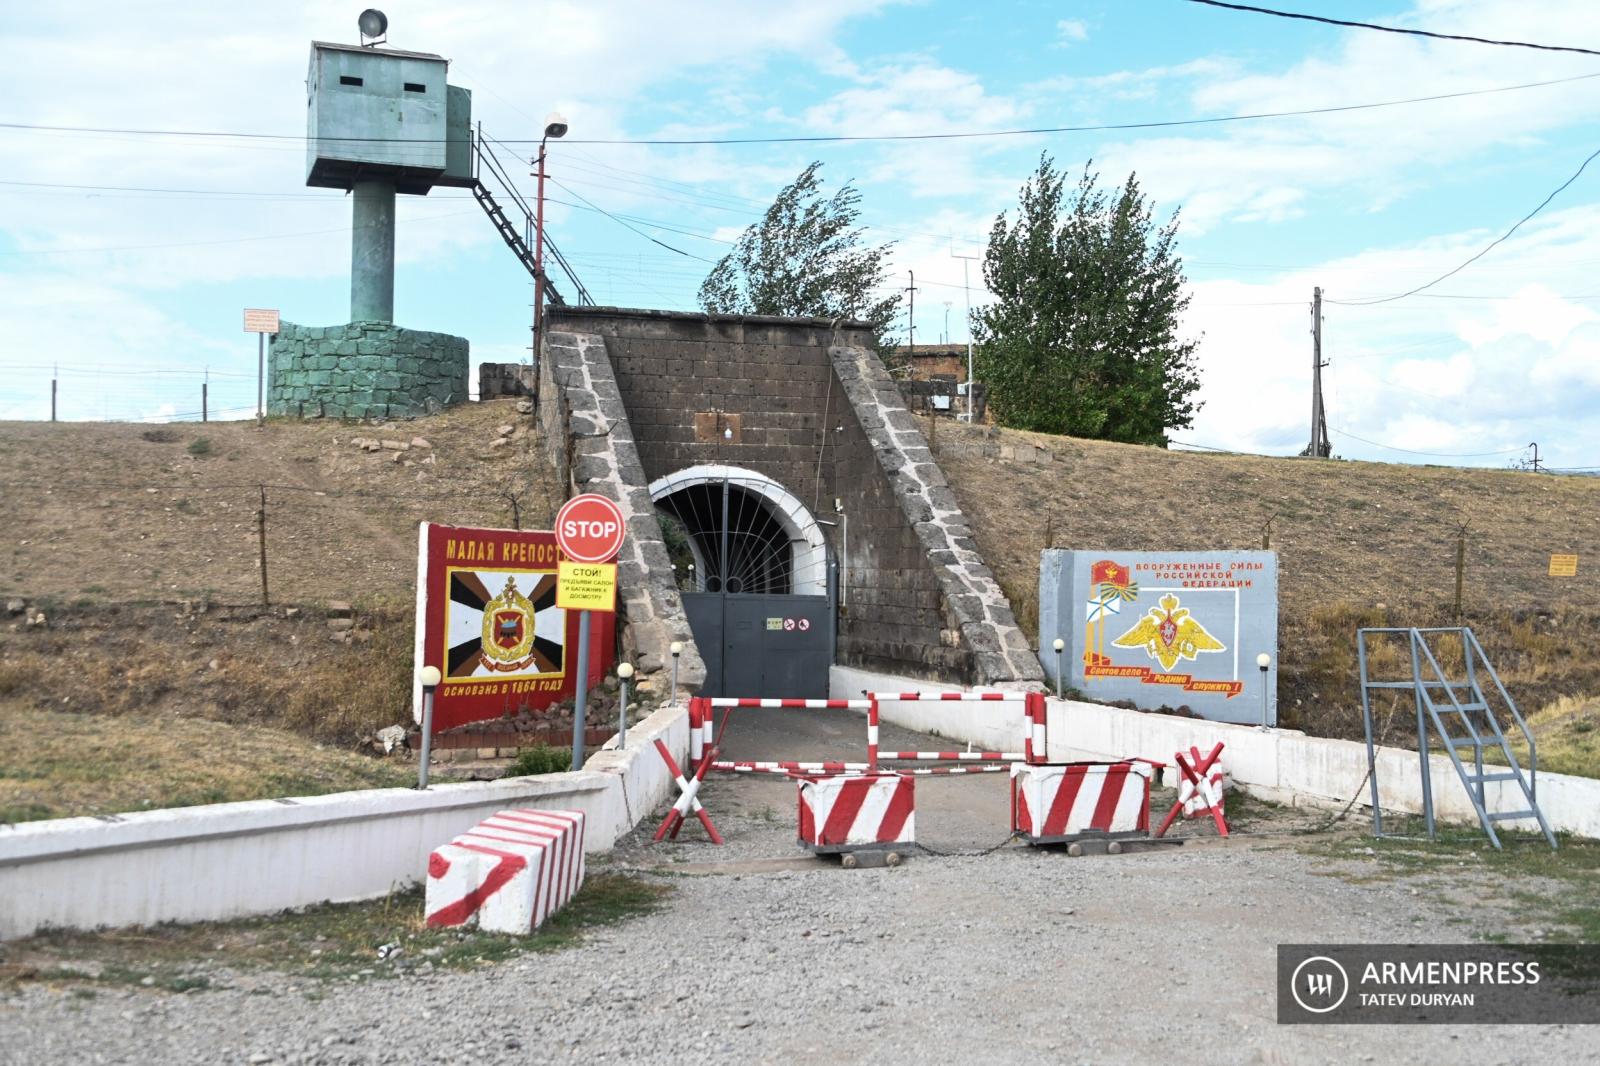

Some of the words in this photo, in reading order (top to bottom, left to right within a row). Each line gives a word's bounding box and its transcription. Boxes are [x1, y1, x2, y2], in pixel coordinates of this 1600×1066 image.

[564, 521, 617, 539] STOP
[446, 539, 495, 561] МАЛАЯ
[1135, 562, 1222, 570] ВООРУЖЕННЫЕ
[1230, 562, 1264, 570] СИЛЫ
[572, 567, 602, 577] СТОЙ!
[1156, 570, 1233, 579] РОССИЙСКОЙ
[1182, 580, 1252, 588] ФЕДЕРАЦИИ
[512, 681, 536, 694] 1864
